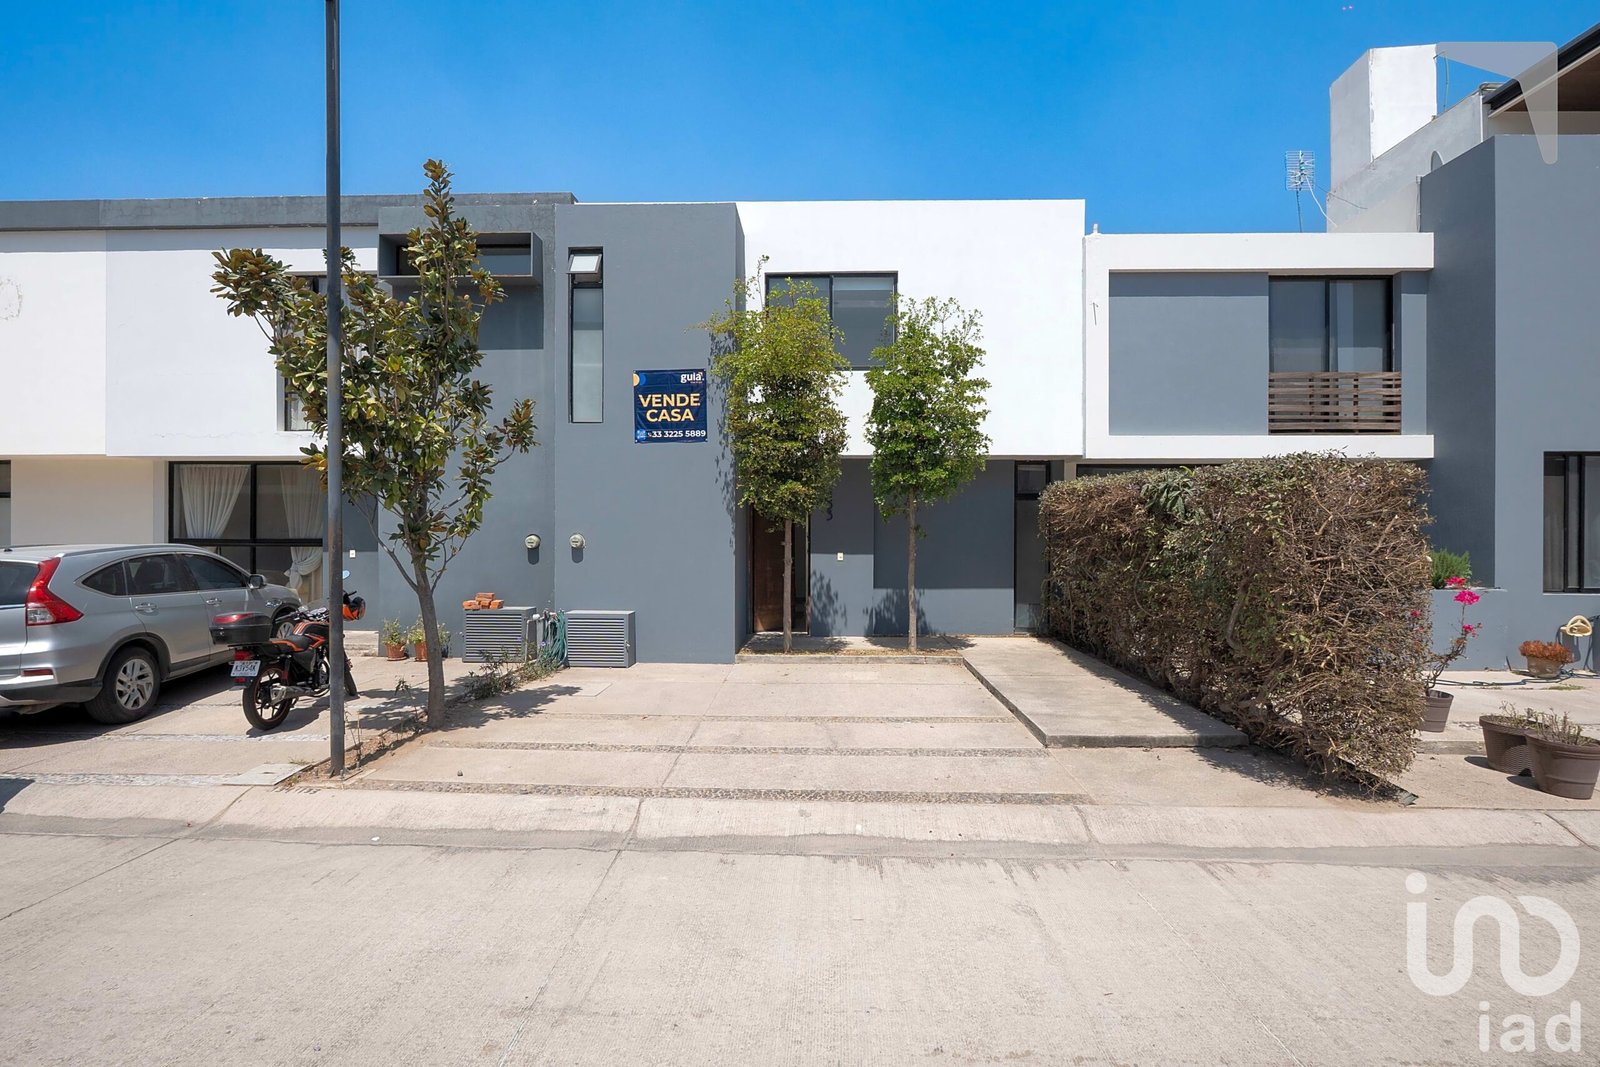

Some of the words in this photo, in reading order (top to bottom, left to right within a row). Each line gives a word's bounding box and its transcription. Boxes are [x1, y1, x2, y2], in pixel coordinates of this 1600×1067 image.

[638, 393, 701, 407] VENDE
[646, 408, 695, 422] CASA
[663, 430, 684, 438] 3225
[685, 429, 706, 437] 5889
